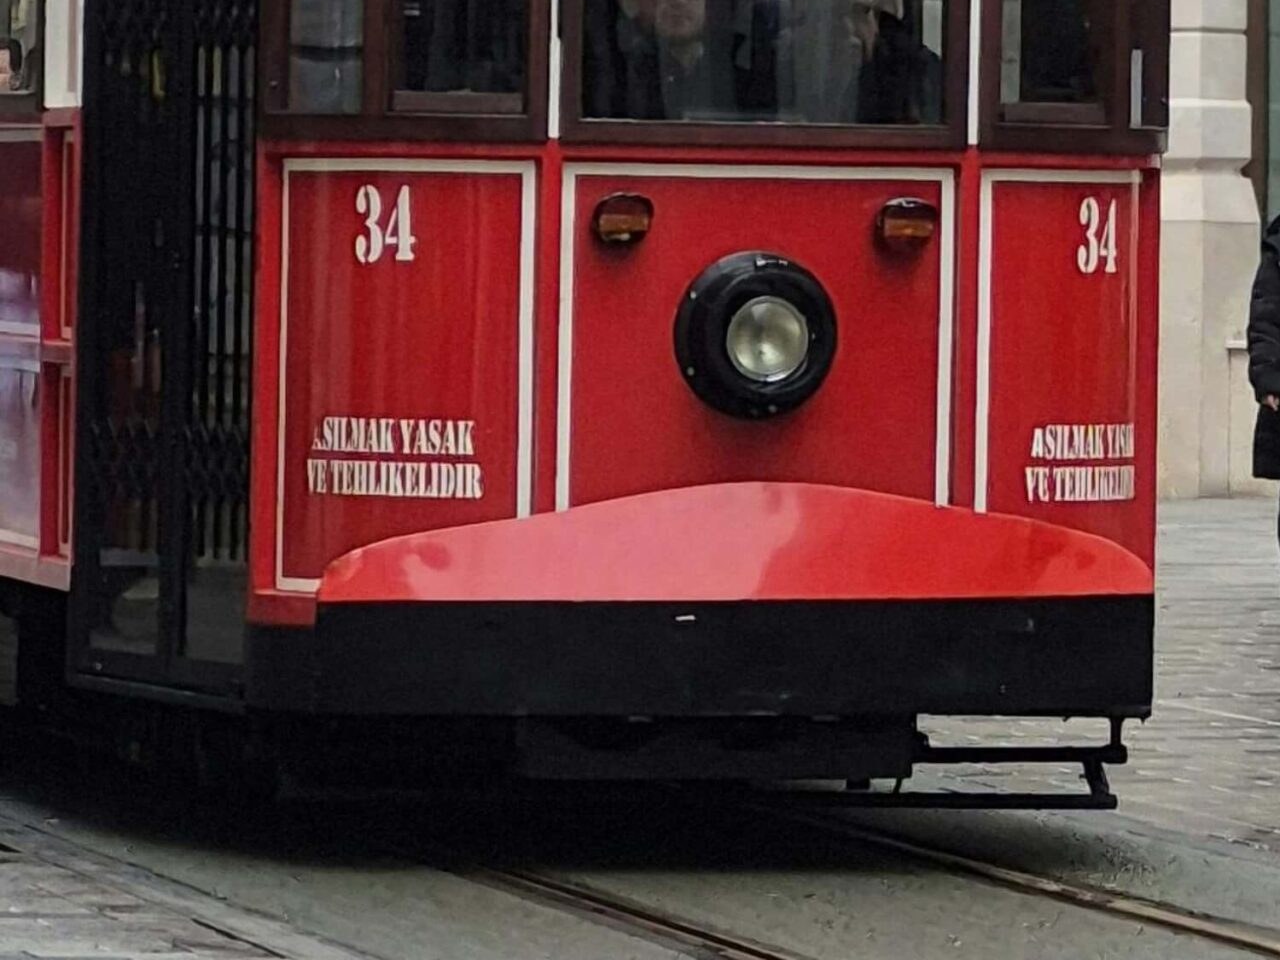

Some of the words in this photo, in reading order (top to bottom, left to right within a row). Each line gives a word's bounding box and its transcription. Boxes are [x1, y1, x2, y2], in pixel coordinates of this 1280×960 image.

[355, 184, 416, 264] 34
[1077, 196, 1118, 274] 34
[399, 419, 476, 455] YASAK
[1031, 424, 1105, 460] ASILMAK
[307, 458, 327, 495] VE
